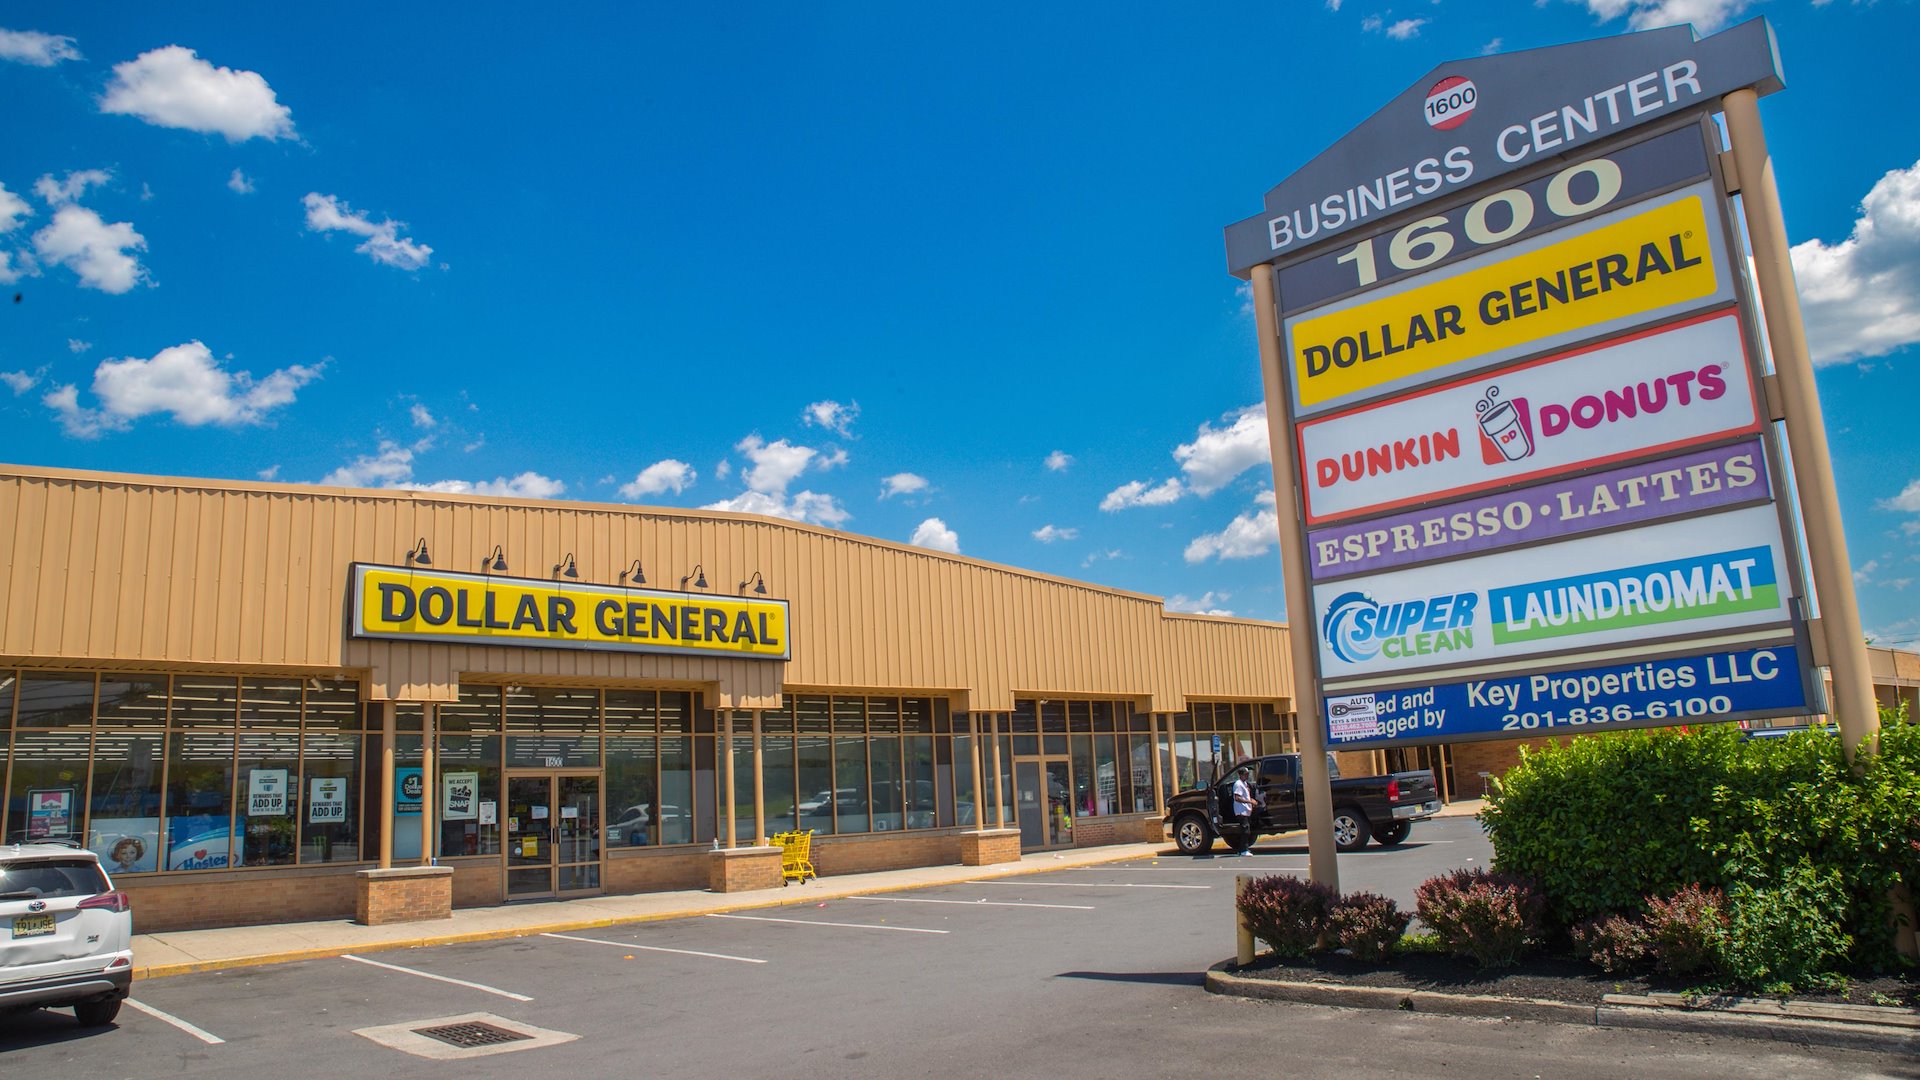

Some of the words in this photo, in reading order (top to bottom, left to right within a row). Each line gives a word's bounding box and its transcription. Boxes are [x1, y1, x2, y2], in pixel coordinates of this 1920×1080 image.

[1426, 86, 1476, 117] 1600
[1267, 145, 1475, 251] BUSINESS
[1496, 59, 1700, 164] CENTER
[1338, 158, 1622, 287] 1600
[1303, 304, 1465, 378] DOLLAR
[1479, 234, 1702, 326] GENERAL
[1316, 427, 1460, 488] DUNKIN
[1539, 364, 1727, 438] DONUTS
[1500, 429, 1517, 444] DD
[1316, 500, 1532, 567] ESPRESSO
[1558, 454, 1757, 522] LATTES
[1503, 558, 1757, 633] LAUNDROMAT
[378, 582, 577, 634] DOLLAR
[594, 600, 778, 645] GENERAL
[1351, 591, 1479, 642] SUPER
[1382, 627, 1474, 659] CLEAN
[1467, 680, 1521, 710] Key
[1531, 665, 1697, 707] Properties
[1707, 651, 1780, 686] LLC
[1350, 696, 1374, 706] AUTO
[1402, 686, 1435, 710] and
[1502, 695, 1732, 731] 201-836-6100
[1424, 709, 1446, 729] by
[252, 799, 271, 808] ADD
[271, 798, 283, 808] UP.
[312, 807, 329, 817] ADD
[331, 806, 343, 816] UP.
[449, 800, 469, 808] SNAP
[183, 855, 230, 870] Hostes
